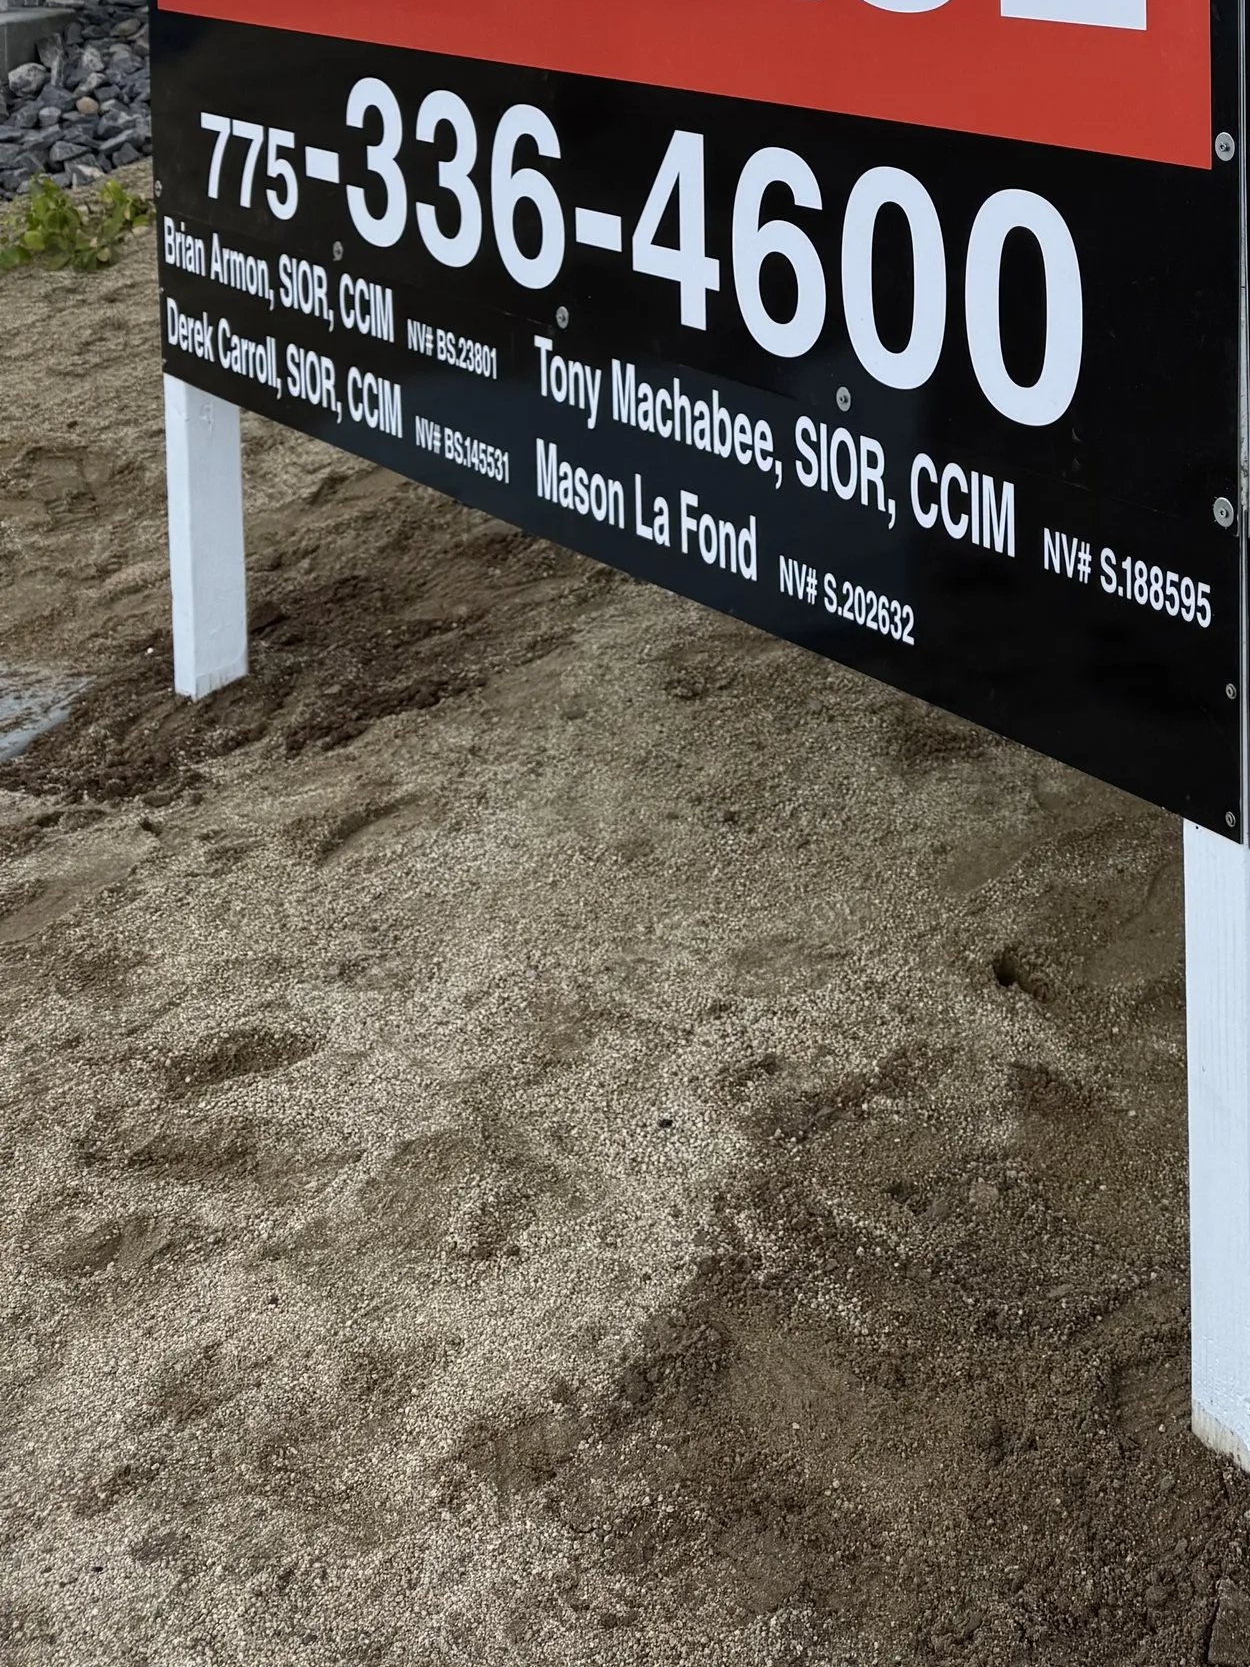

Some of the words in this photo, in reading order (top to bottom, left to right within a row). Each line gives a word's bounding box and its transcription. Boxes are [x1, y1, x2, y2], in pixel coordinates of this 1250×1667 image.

[164, 216, 205, 276] Brian
[211, 233, 274, 310] Armon,
[279, 254, 333, 331] SIOR,
[340, 274, 394, 342] CCIM
[408, 319, 433, 355] NV#
[437, 329, 497, 380] BS.23801
[201, 78, 1082, 426] 775-336-4600
[167, 298, 214, 362] Derek
[218, 318, 281, 399] Carroll,
[287, 344, 341, 423] SIOR,
[348, 367, 402, 438] CCIM
[416, 416, 441, 453] NV#
[444, 428, 510, 484] BS.145531
[534, 335, 601, 429] Tony
[612, 359, 783, 489] Machabee,
[795, 416, 896, 529] SIOR,
[911, 453, 1015, 557] CCIM
[1044, 528, 1091, 584] NV#
[1101, 548, 1212, 628] S.188595
[537, 438, 625, 538] Mason
[635, 474, 670, 547] La
[681, 490, 757, 581] Fond
[780, 556, 817, 604] NV#
[824, 573, 915, 645] S.202632
